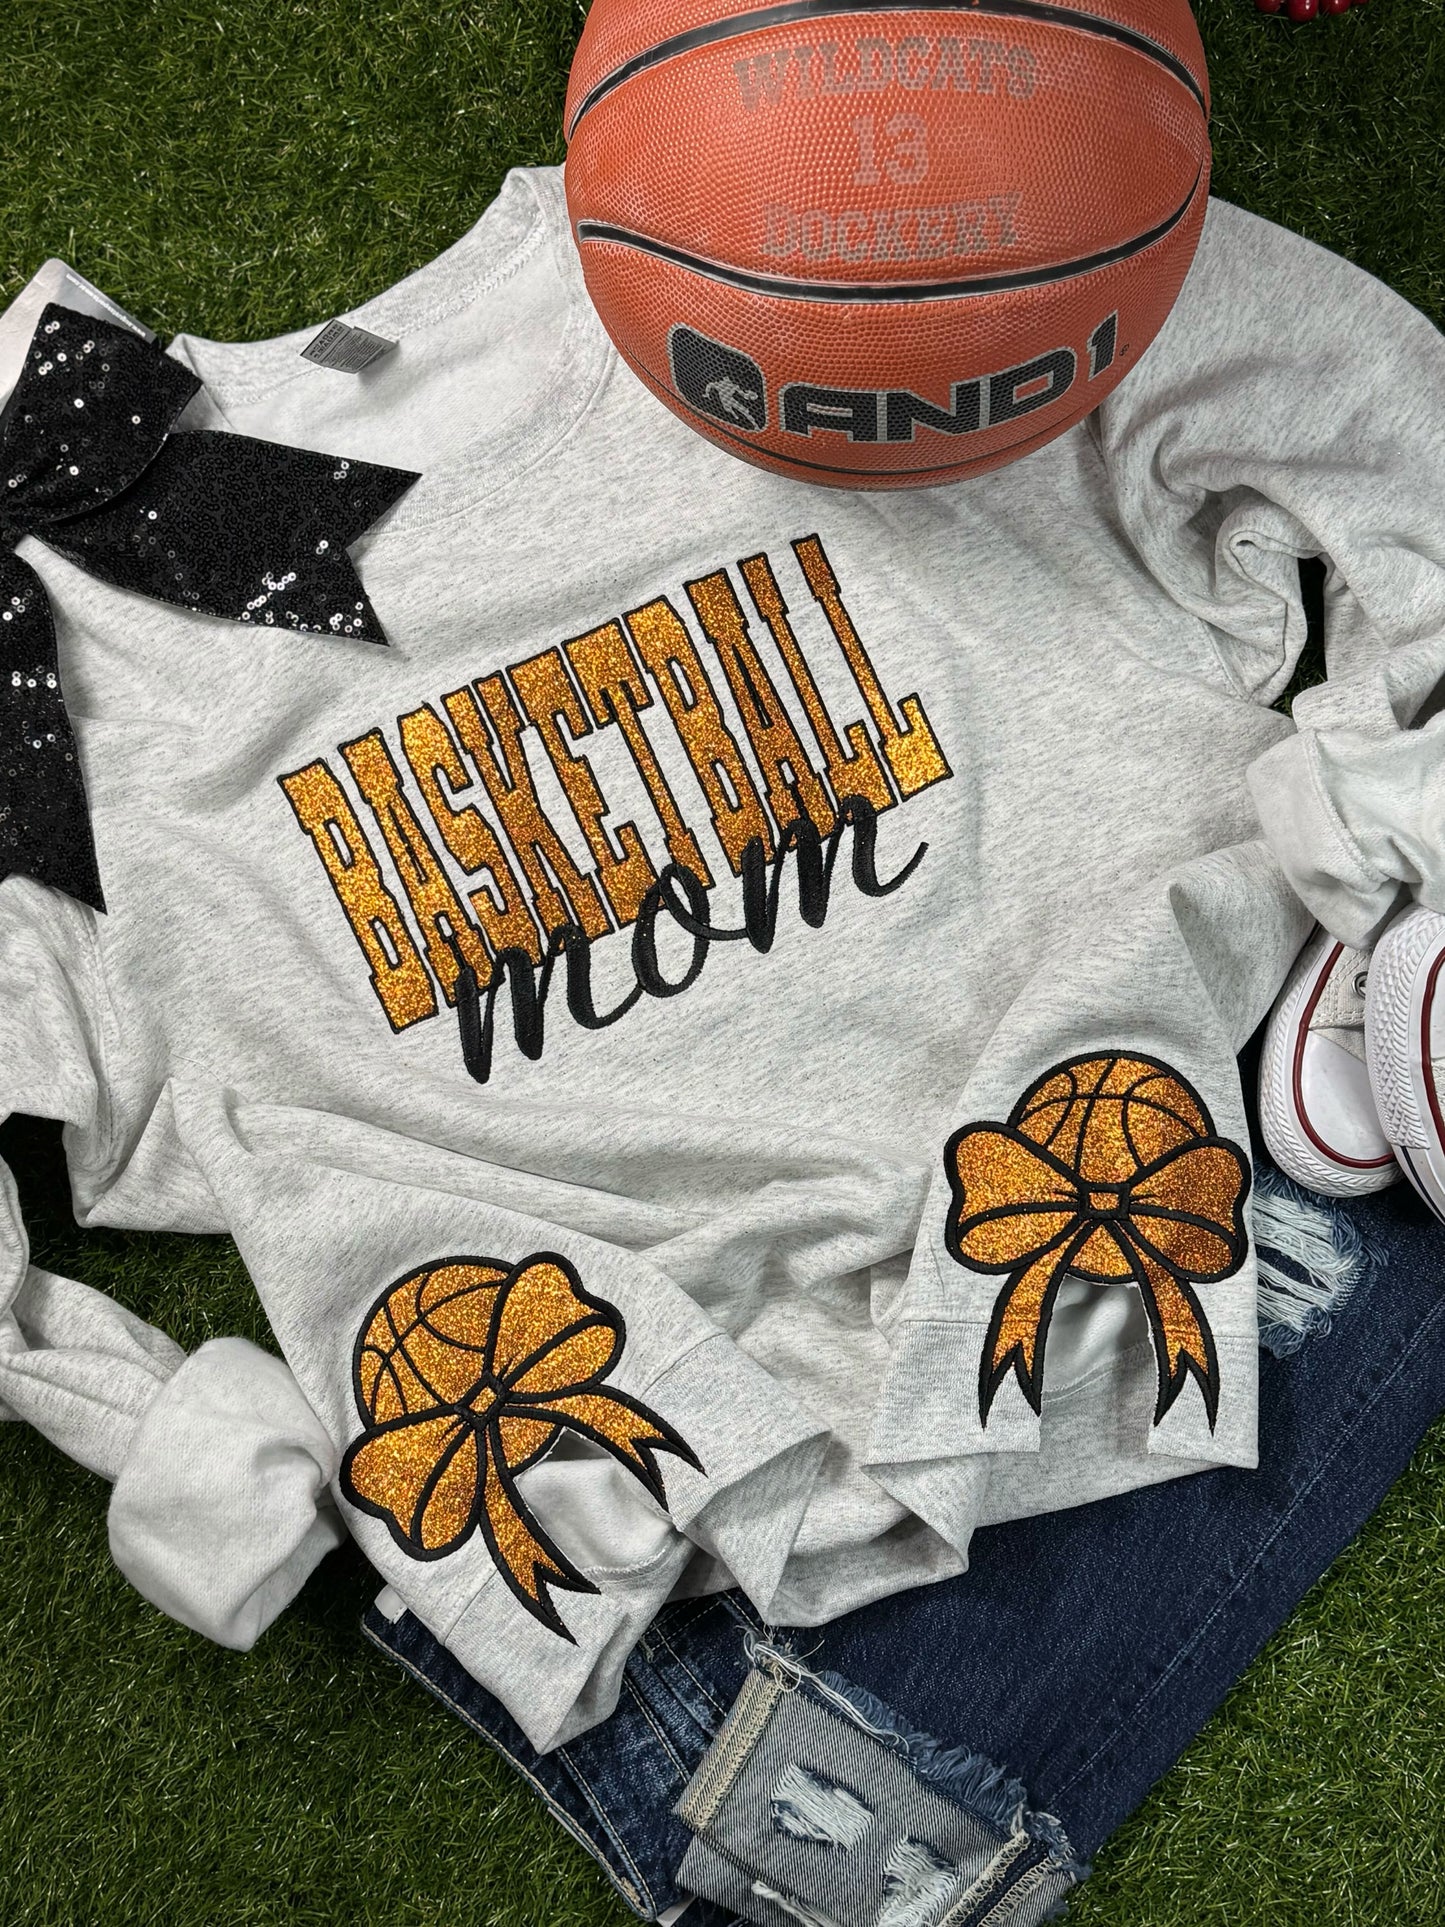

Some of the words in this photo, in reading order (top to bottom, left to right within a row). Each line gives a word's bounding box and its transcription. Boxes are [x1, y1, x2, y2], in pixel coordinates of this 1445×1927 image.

[733, 36, 1038, 112] WILDCATS
[852, 111, 929, 186] 13
[759, 192, 1022, 264] DOCKERY
[277, 533, 954, 1035] BASKETBALL
[452, 796, 930, 1085] mom
